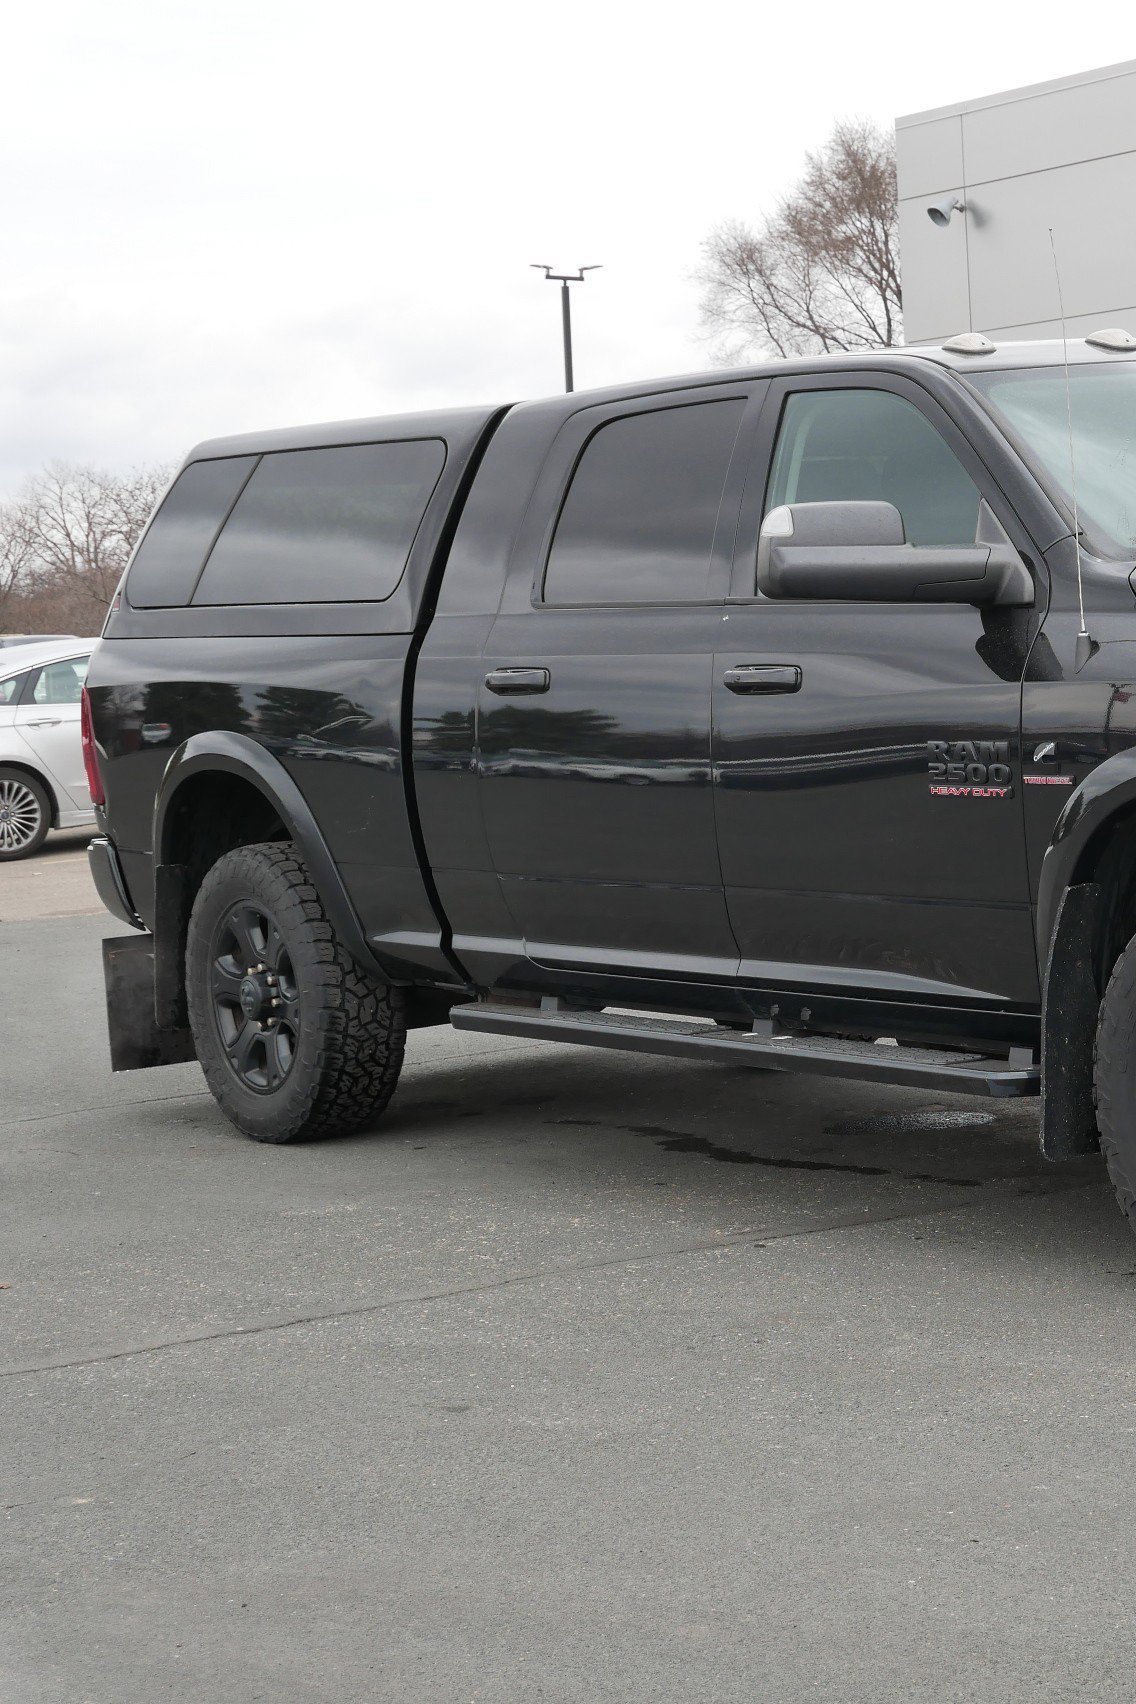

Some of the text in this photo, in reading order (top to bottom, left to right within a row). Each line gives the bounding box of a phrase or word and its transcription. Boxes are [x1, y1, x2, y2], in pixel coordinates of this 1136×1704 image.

[927, 740, 1011, 762] RAM
[927, 762, 1013, 785] 2500
[930, 786, 1008, 798] HEAVY DUTY
